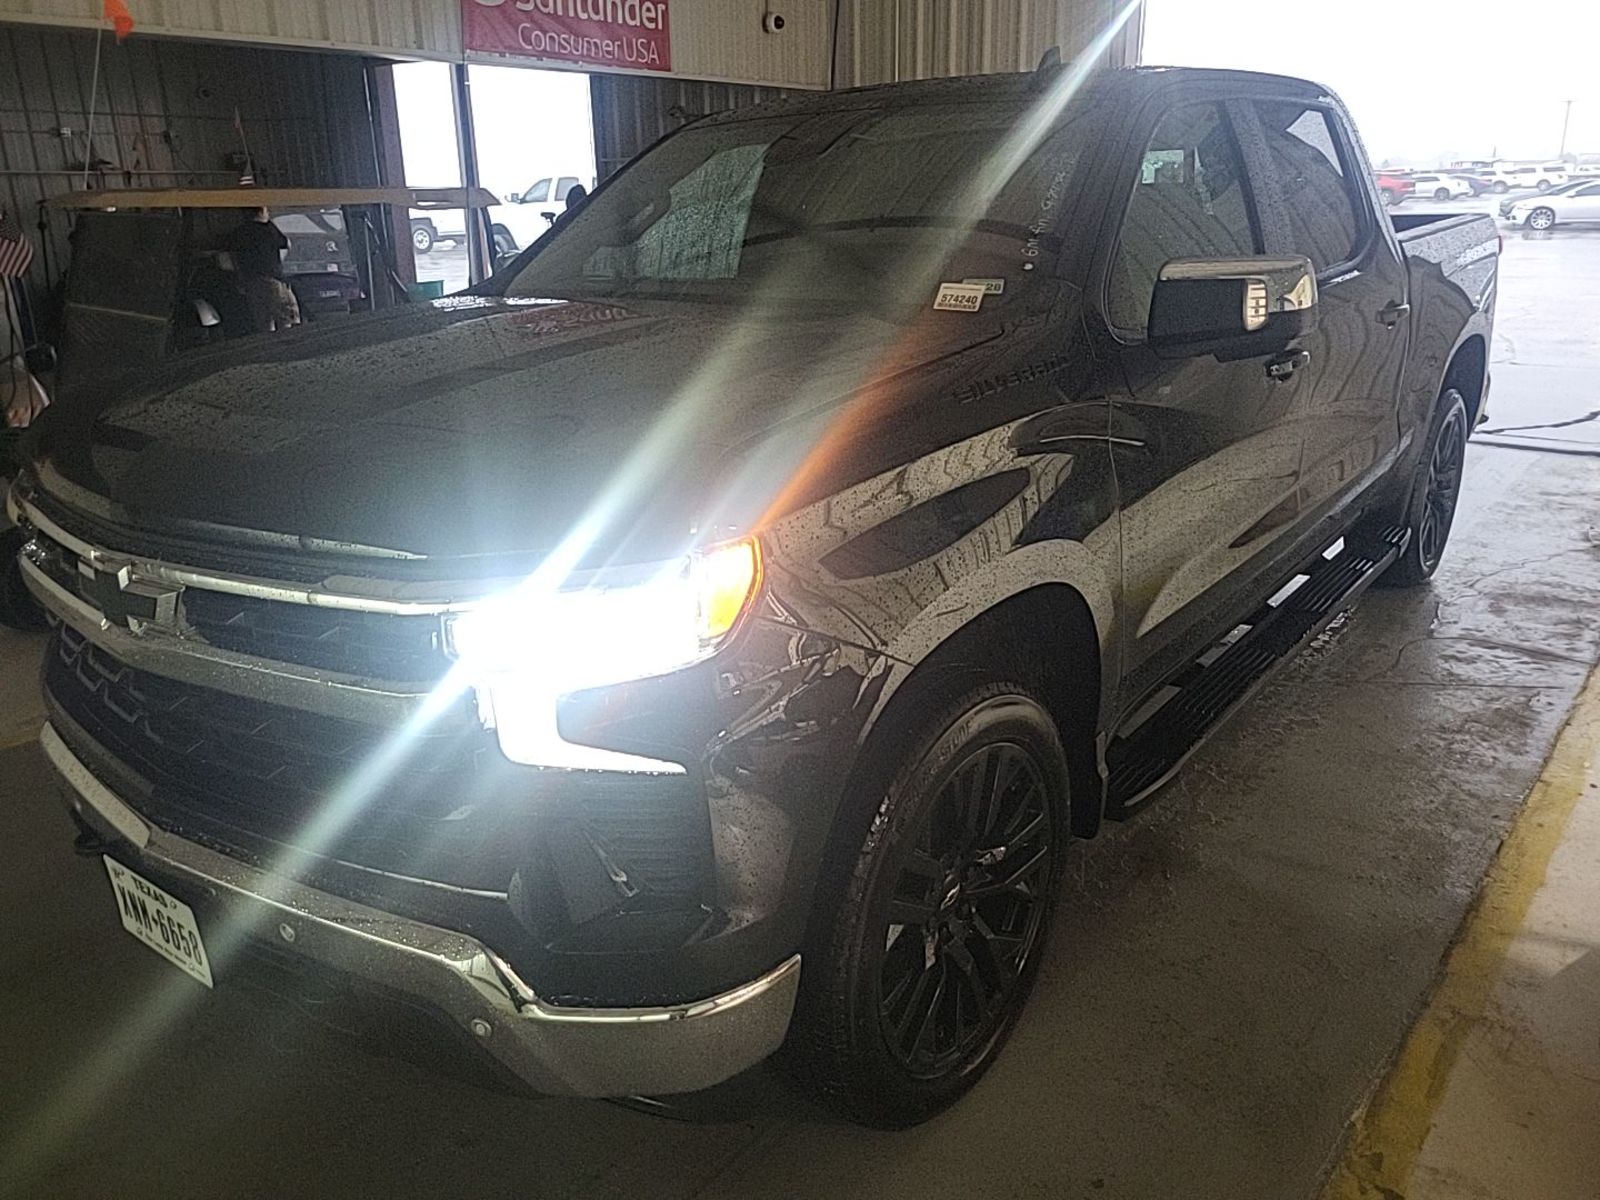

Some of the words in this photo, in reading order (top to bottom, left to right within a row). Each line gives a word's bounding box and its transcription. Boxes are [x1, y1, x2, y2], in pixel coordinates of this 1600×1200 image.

[518, 23, 620, 59] Consumer
[623, 37, 660, 64] USA
[940, 293, 978, 305] 574240
[131, 875, 168, 908] TEXAS
